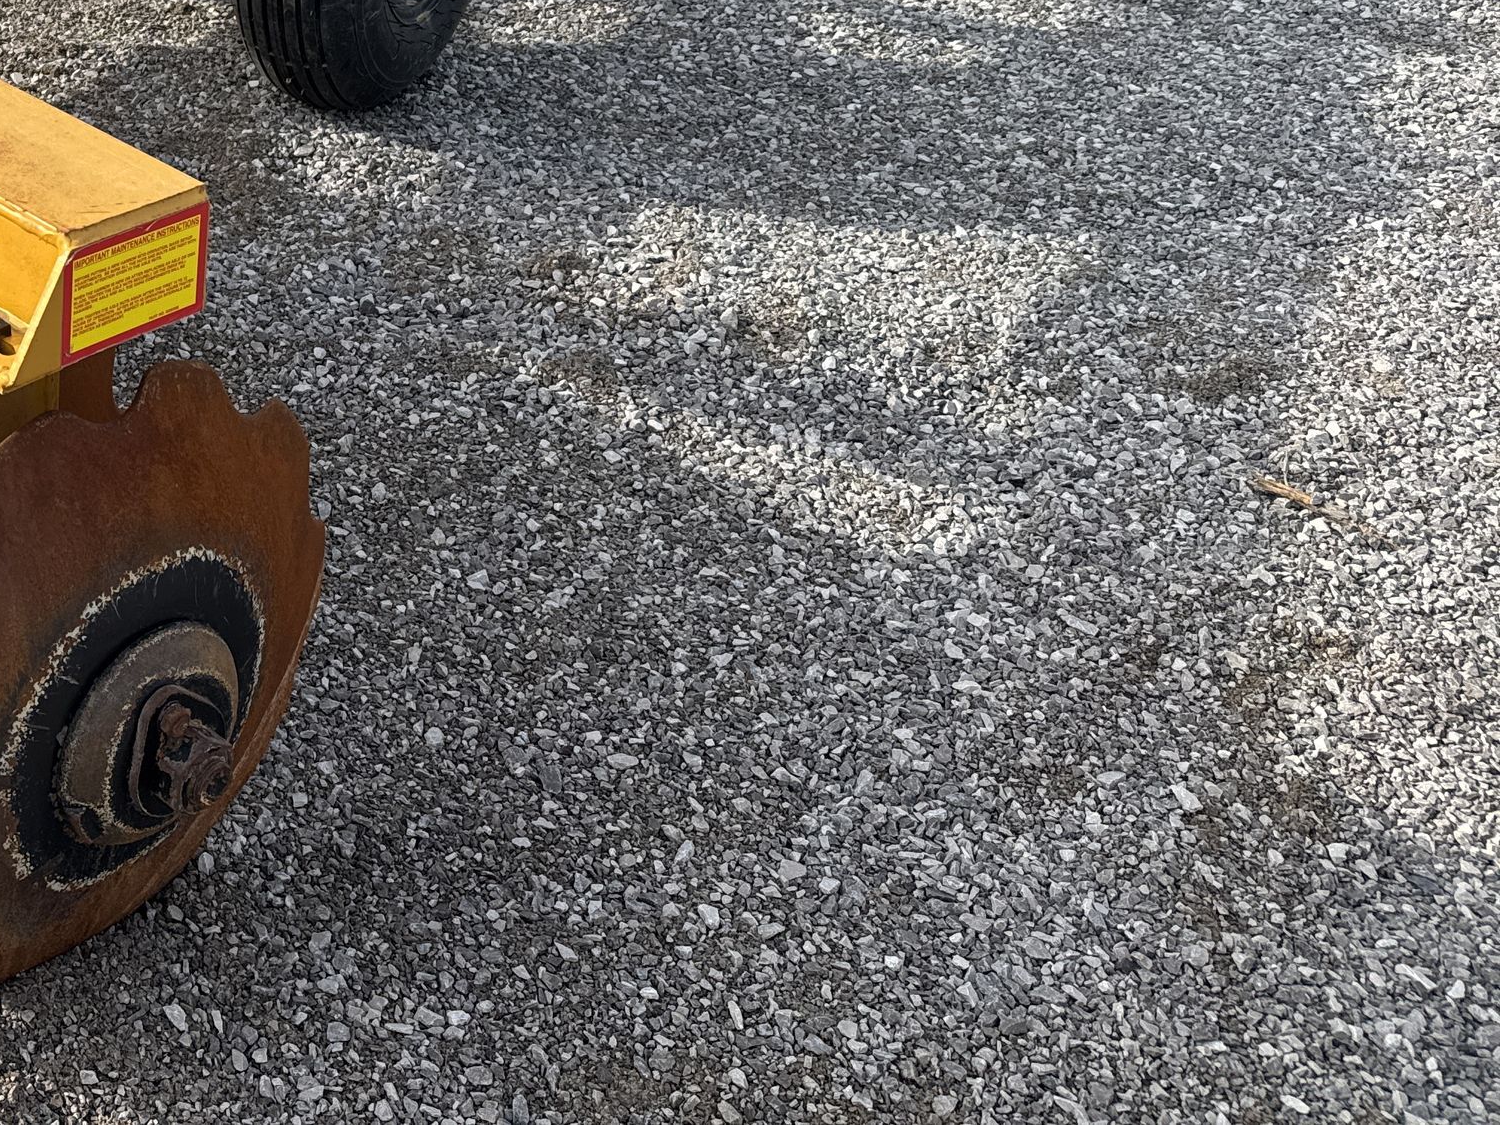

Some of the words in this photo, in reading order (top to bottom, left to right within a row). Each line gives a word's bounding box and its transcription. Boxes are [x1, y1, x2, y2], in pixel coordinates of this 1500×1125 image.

[74, 251, 109, 267] IMPORTANT
[111, 234, 155, 254] MAINTENANCE
[156, 217, 199, 238] INSTRUCTIONS
